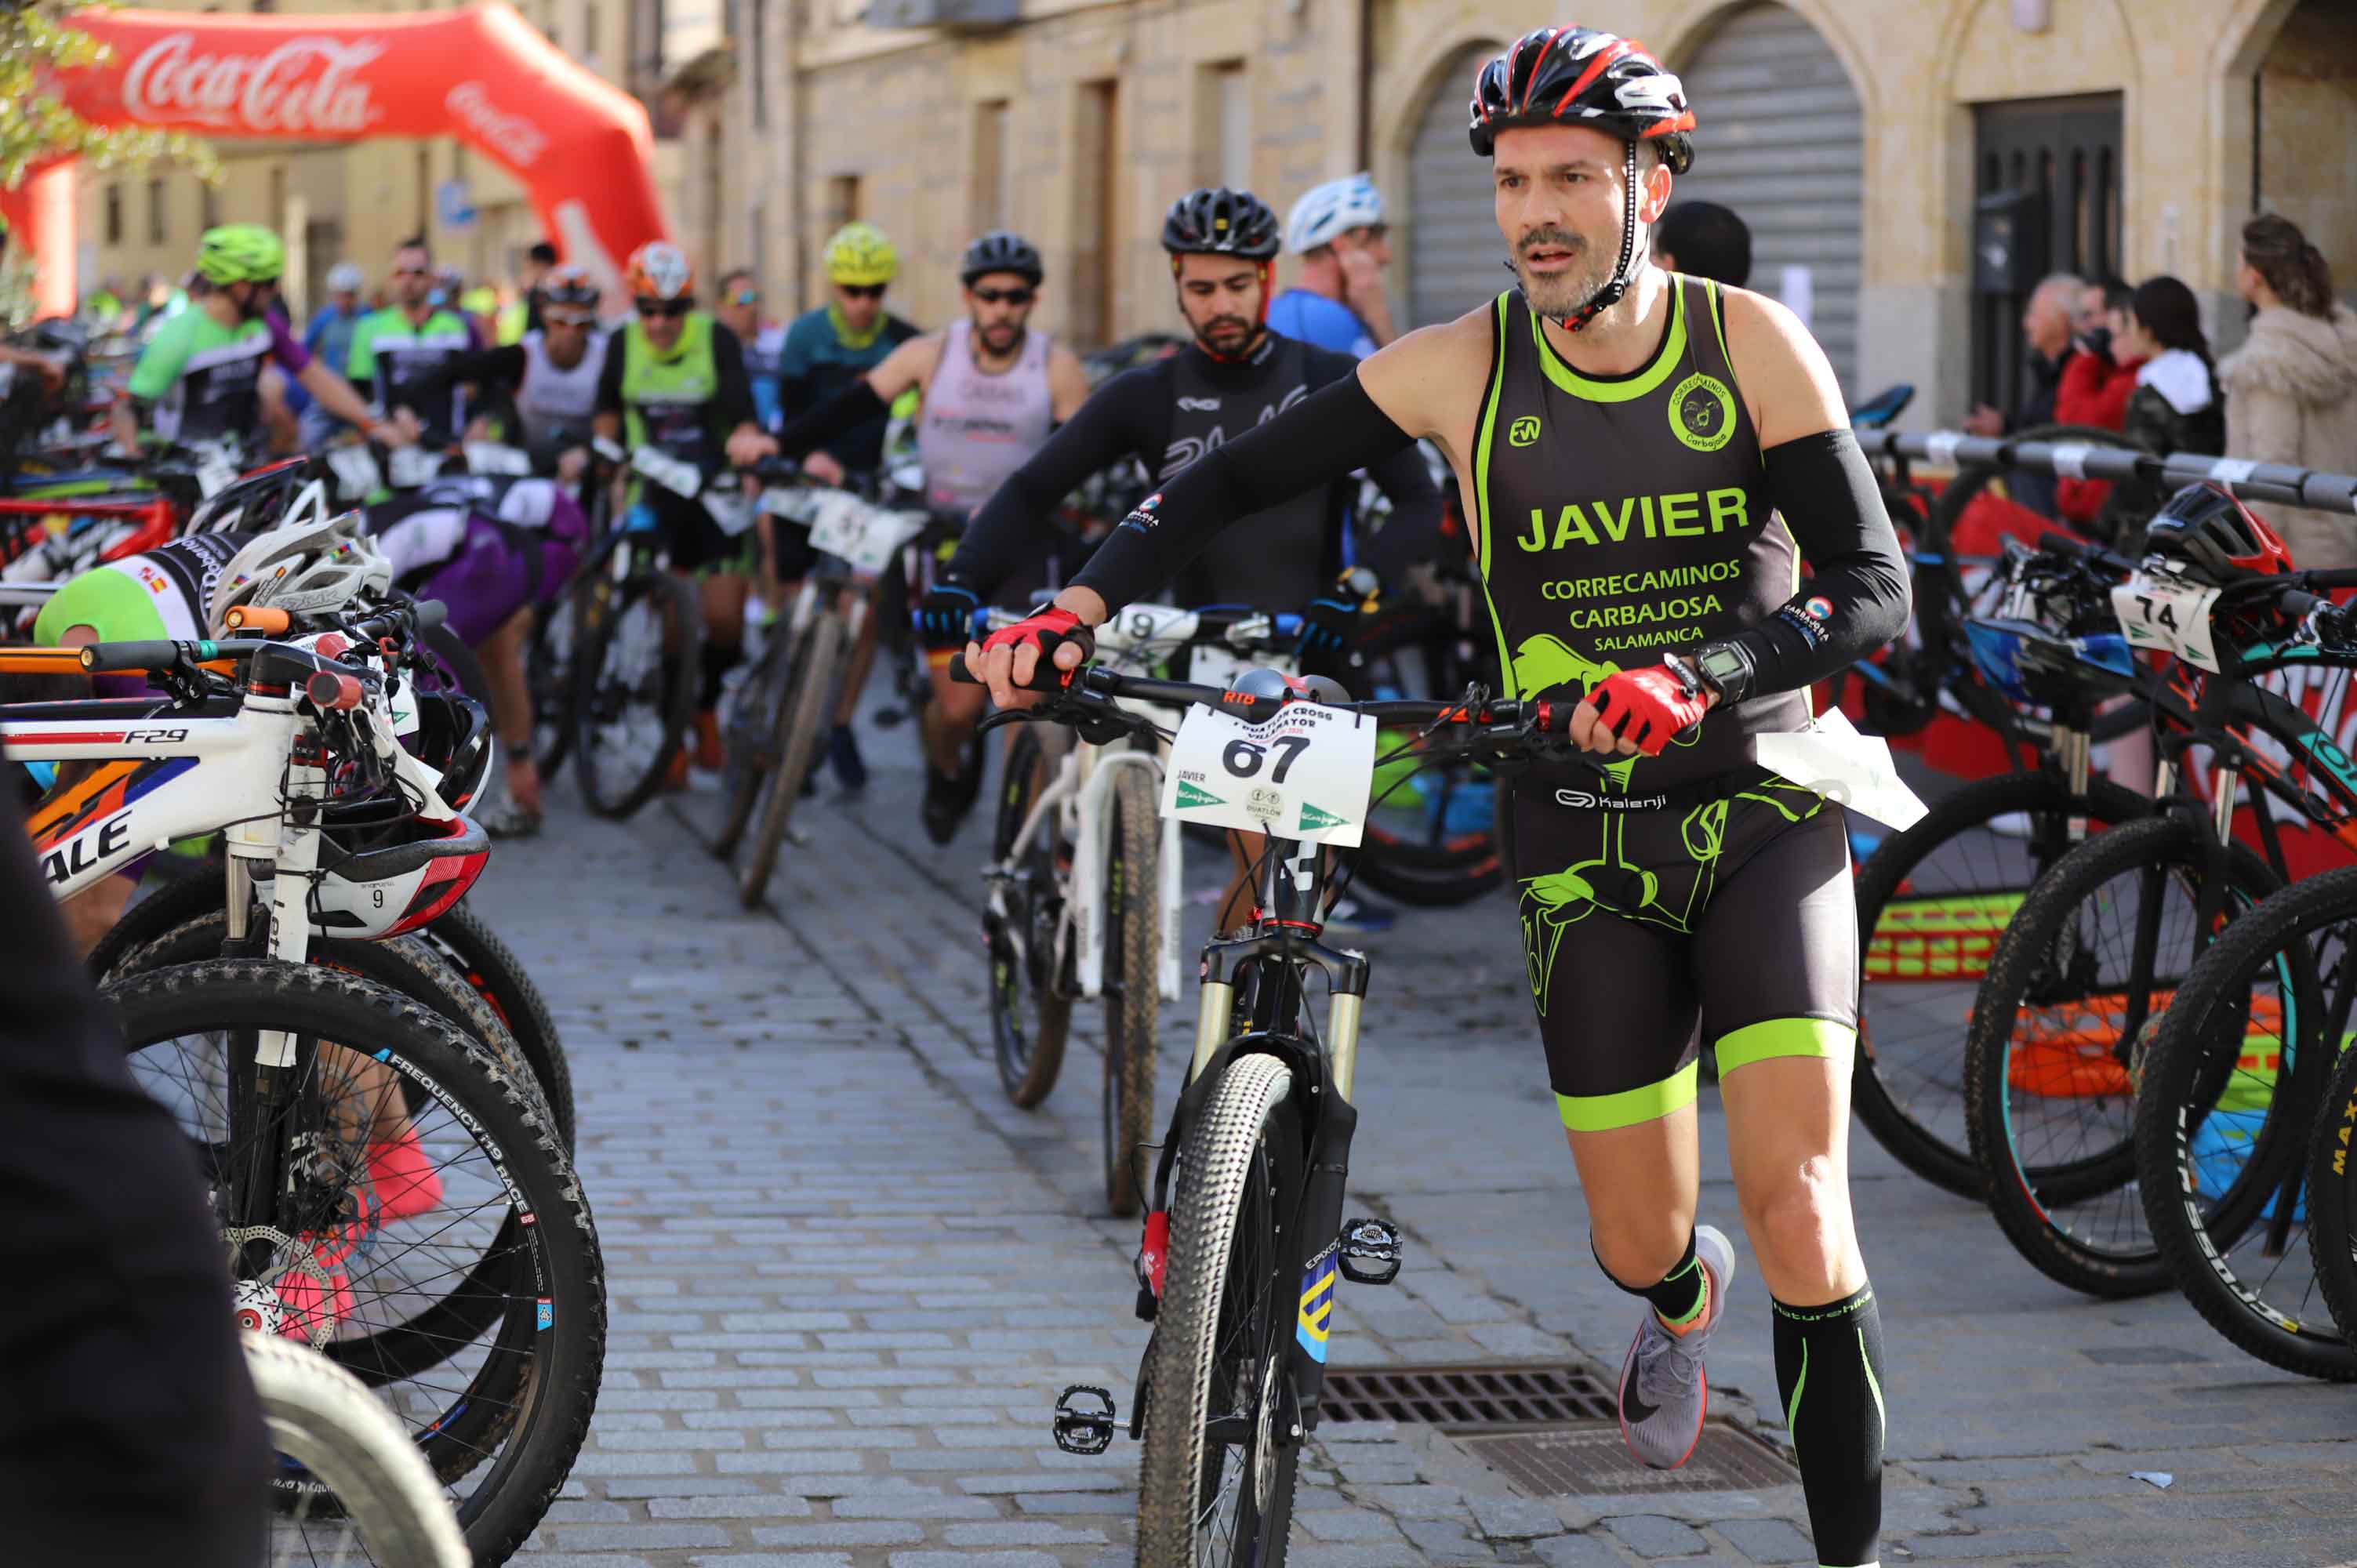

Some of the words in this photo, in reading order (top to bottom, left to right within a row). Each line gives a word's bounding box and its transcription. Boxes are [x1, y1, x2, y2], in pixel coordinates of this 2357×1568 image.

[1517, 488, 1749, 553] JAVIER
[1542, 559, 1741, 601] CORRECAMINOS
[1570, 593, 1723, 630] CARBAJOSA
[2135, 595, 2179, 634] 74
[1594, 626, 1704, 652] SALAMANCA
[1293, 707, 1332, 720] CROSS
[125, 728, 189, 744] F29
[1177, 770, 1206, 782] JAVIER
[1223, 735, 1310, 783] 67
[1599, 794, 1667, 810] Kalenji
[390, 1054, 484, 1134] FREQUENCY
[496, 1164, 528, 1213] RACE
[1773, 1290, 1872, 1322] Naturehike
